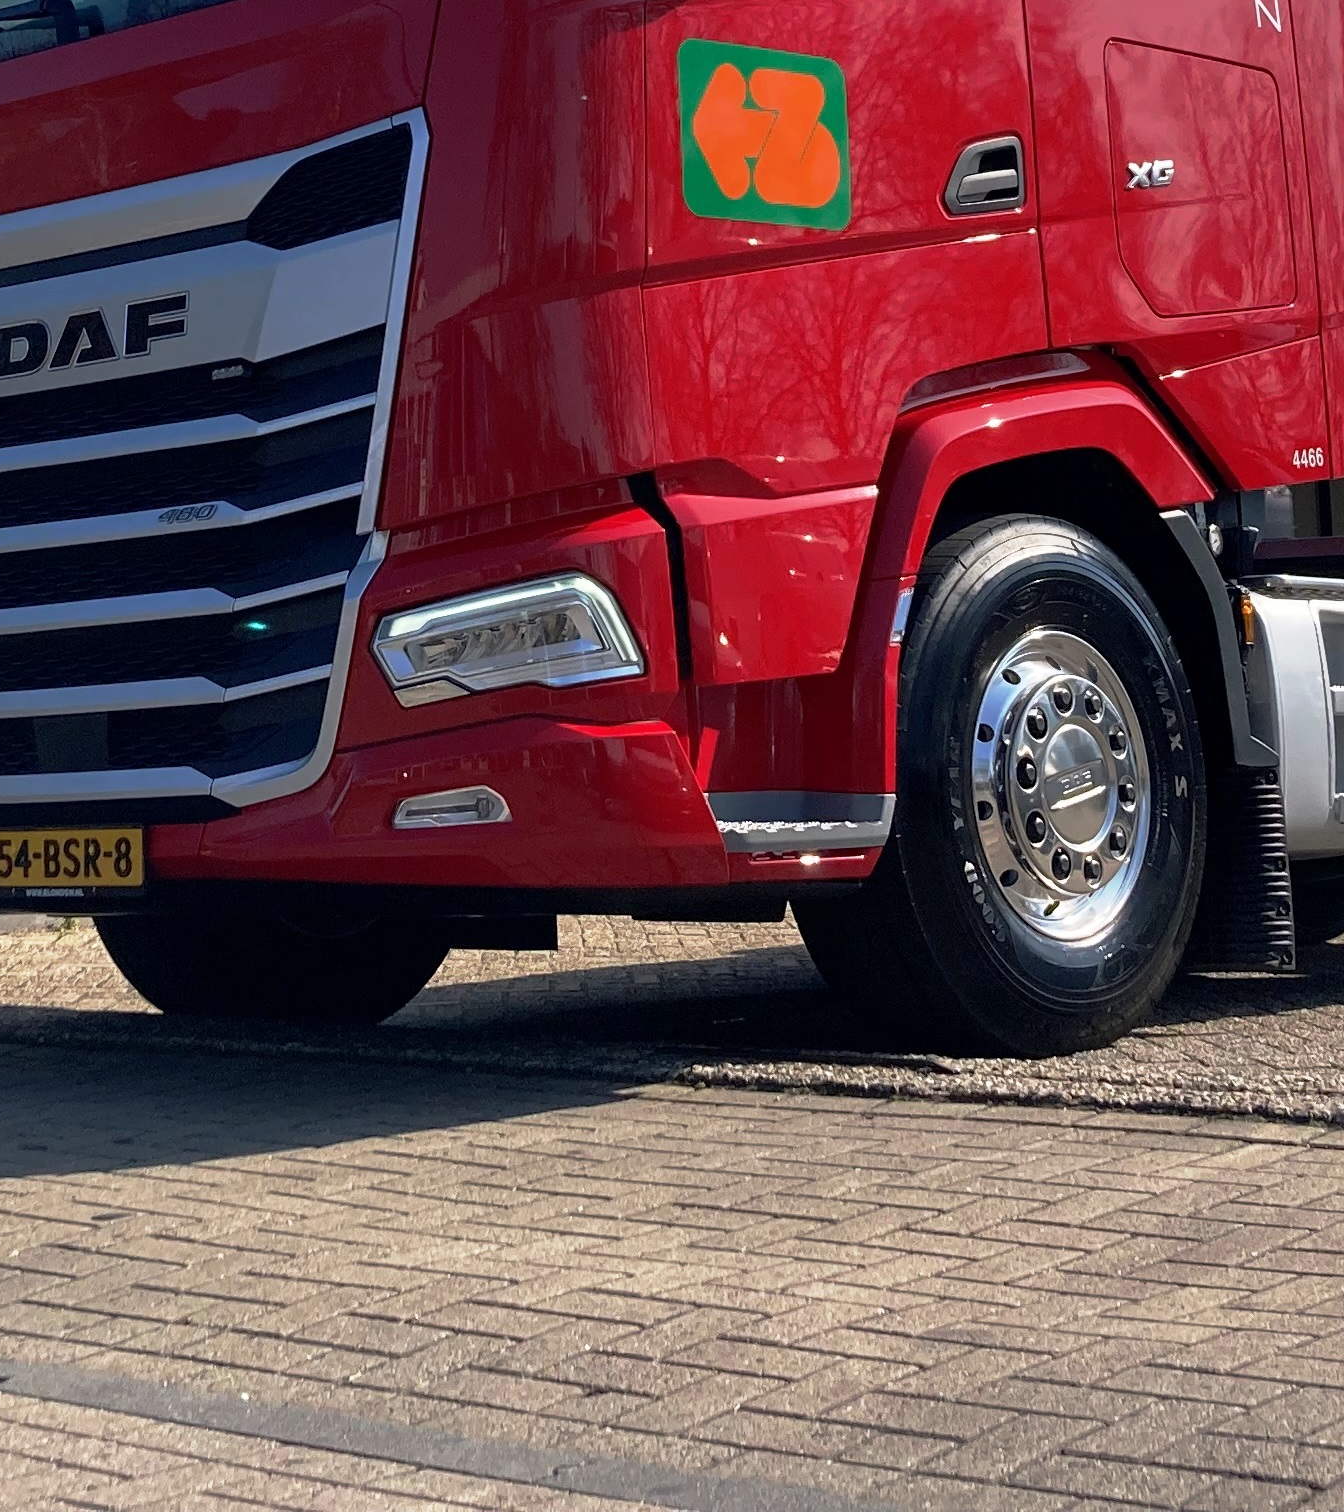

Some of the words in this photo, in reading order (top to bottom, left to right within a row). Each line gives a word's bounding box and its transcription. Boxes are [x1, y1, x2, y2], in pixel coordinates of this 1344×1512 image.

[1127, 159, 1175, 189] XG
[1292, 447, 1324, 469] 4466
[158, 503, 218, 524] 480
